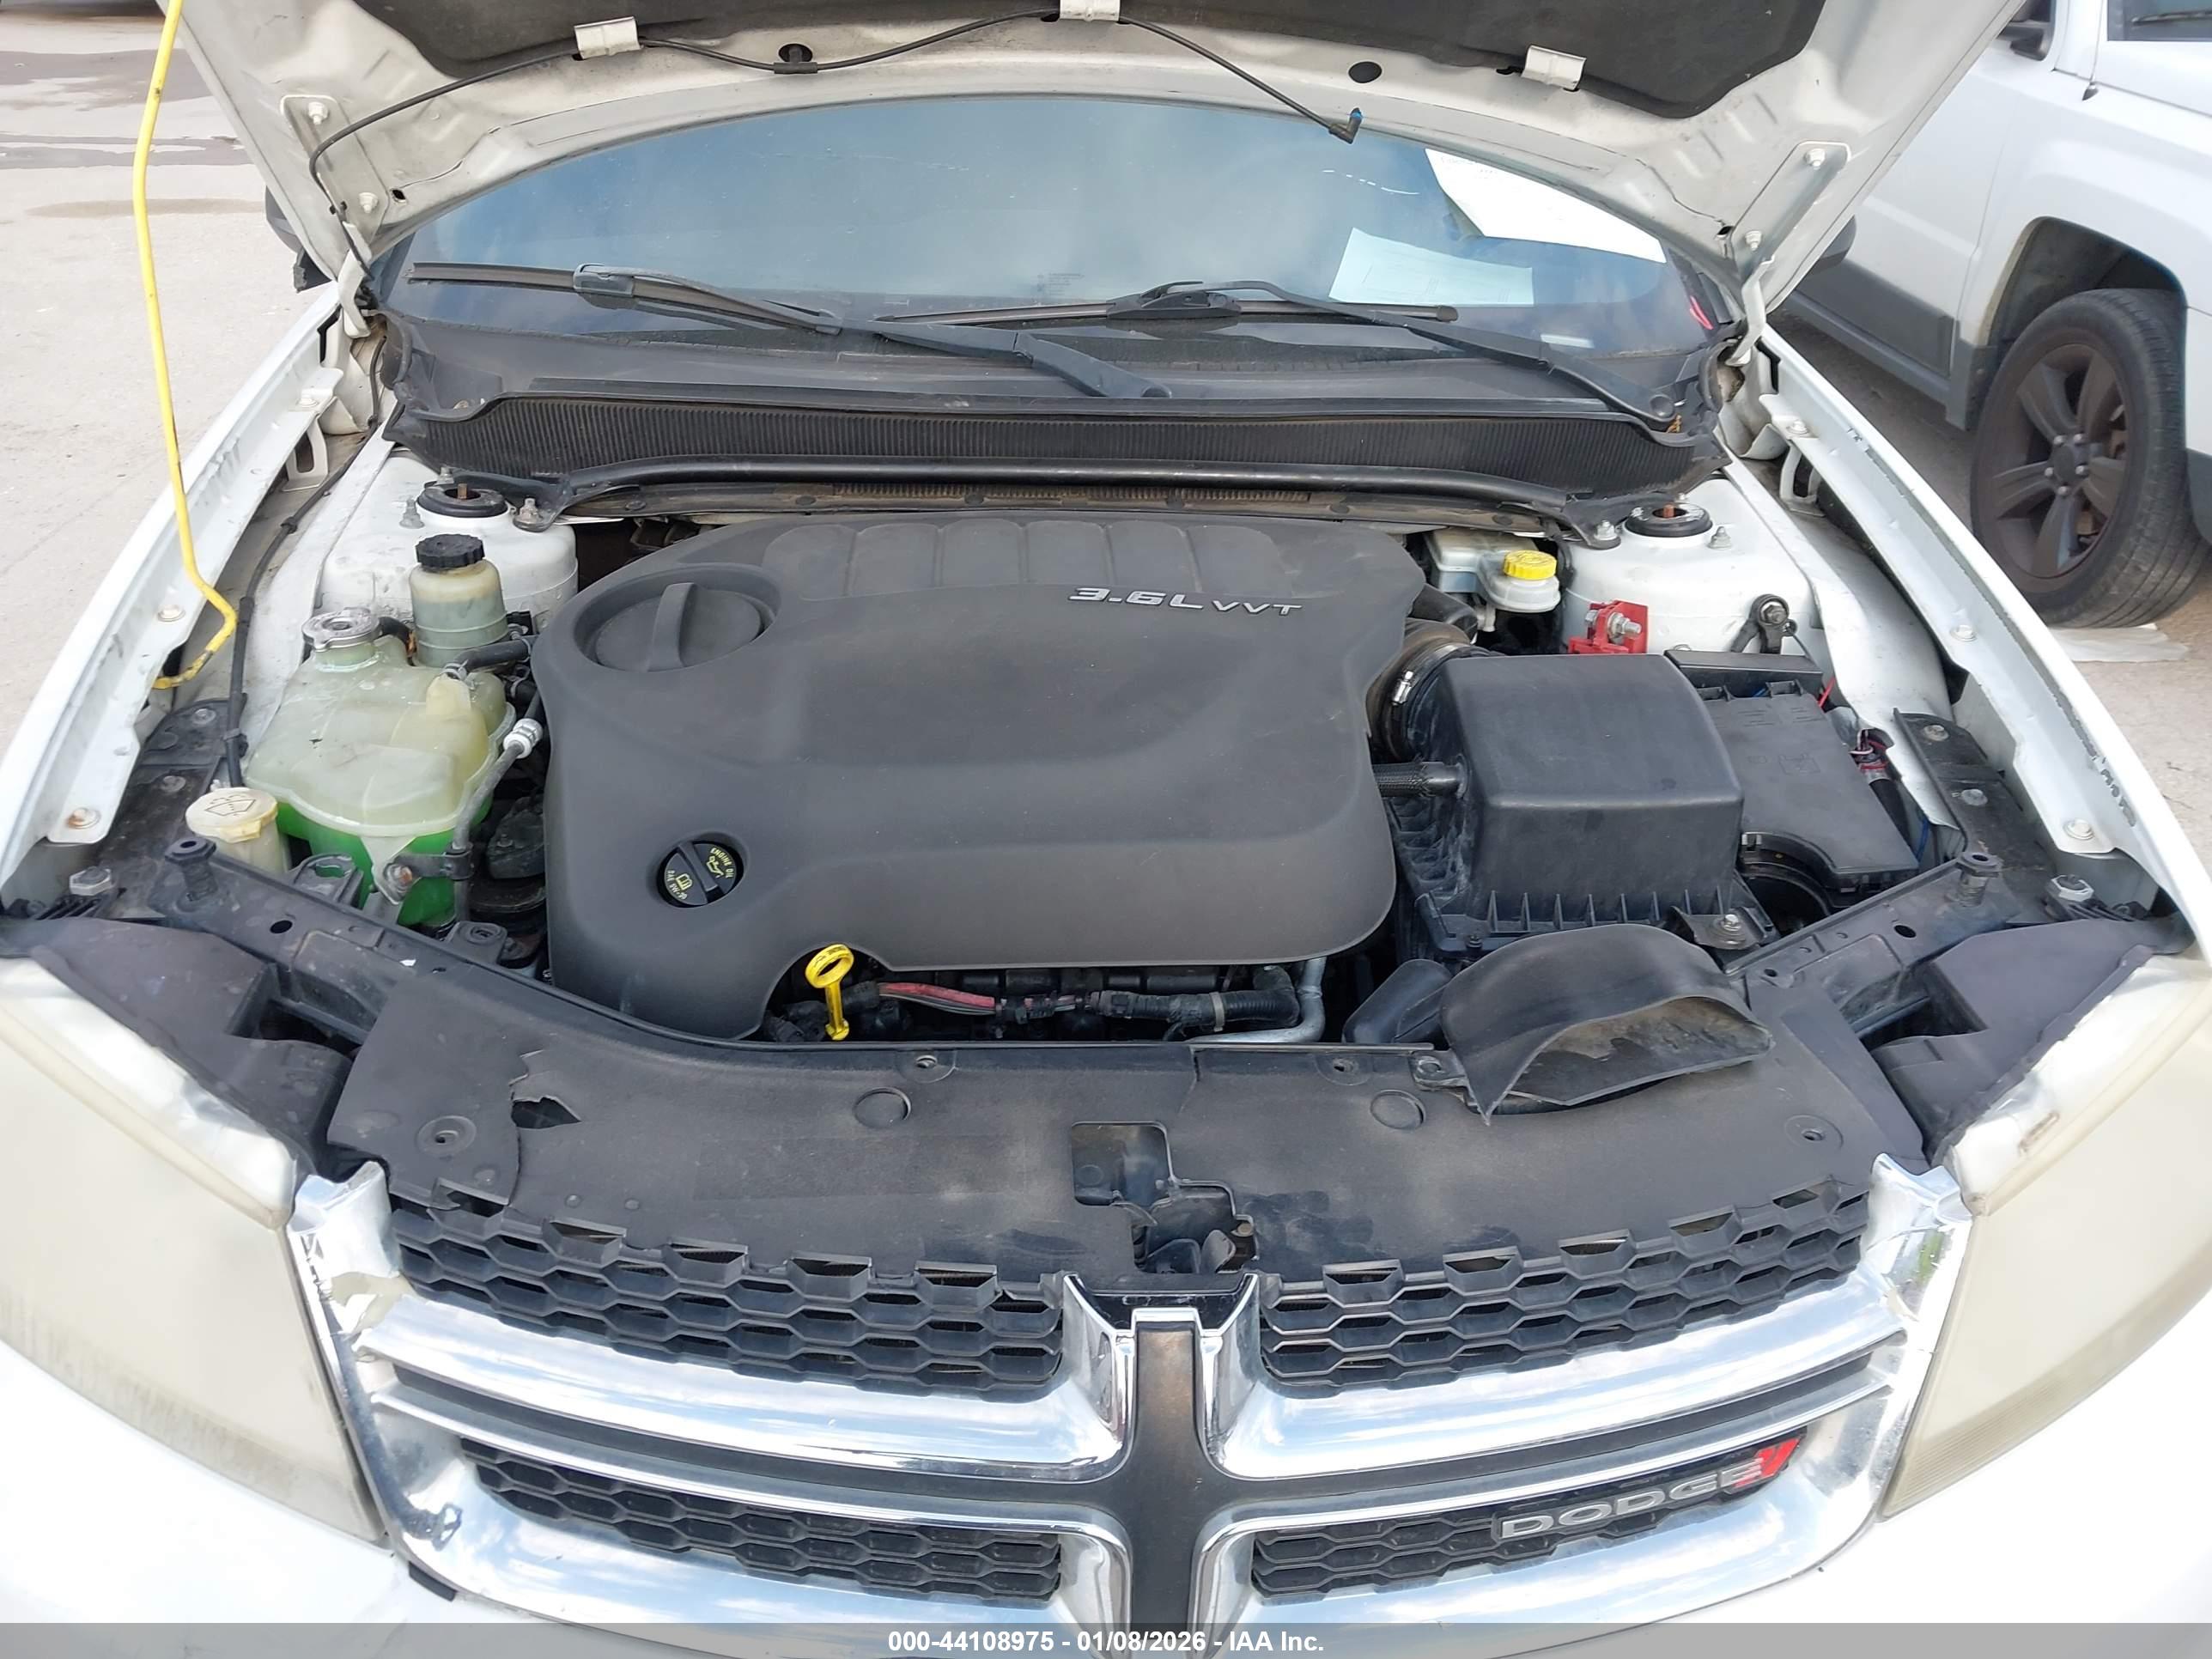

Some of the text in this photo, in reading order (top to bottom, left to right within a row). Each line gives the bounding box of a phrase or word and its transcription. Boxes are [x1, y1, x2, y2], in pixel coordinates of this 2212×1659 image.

[1068, 586, 1303, 616] 3.6L VVT
[709, 847, 735, 878] ENGINE OIL
[1501, 1457, 1763, 1540] DODGE
